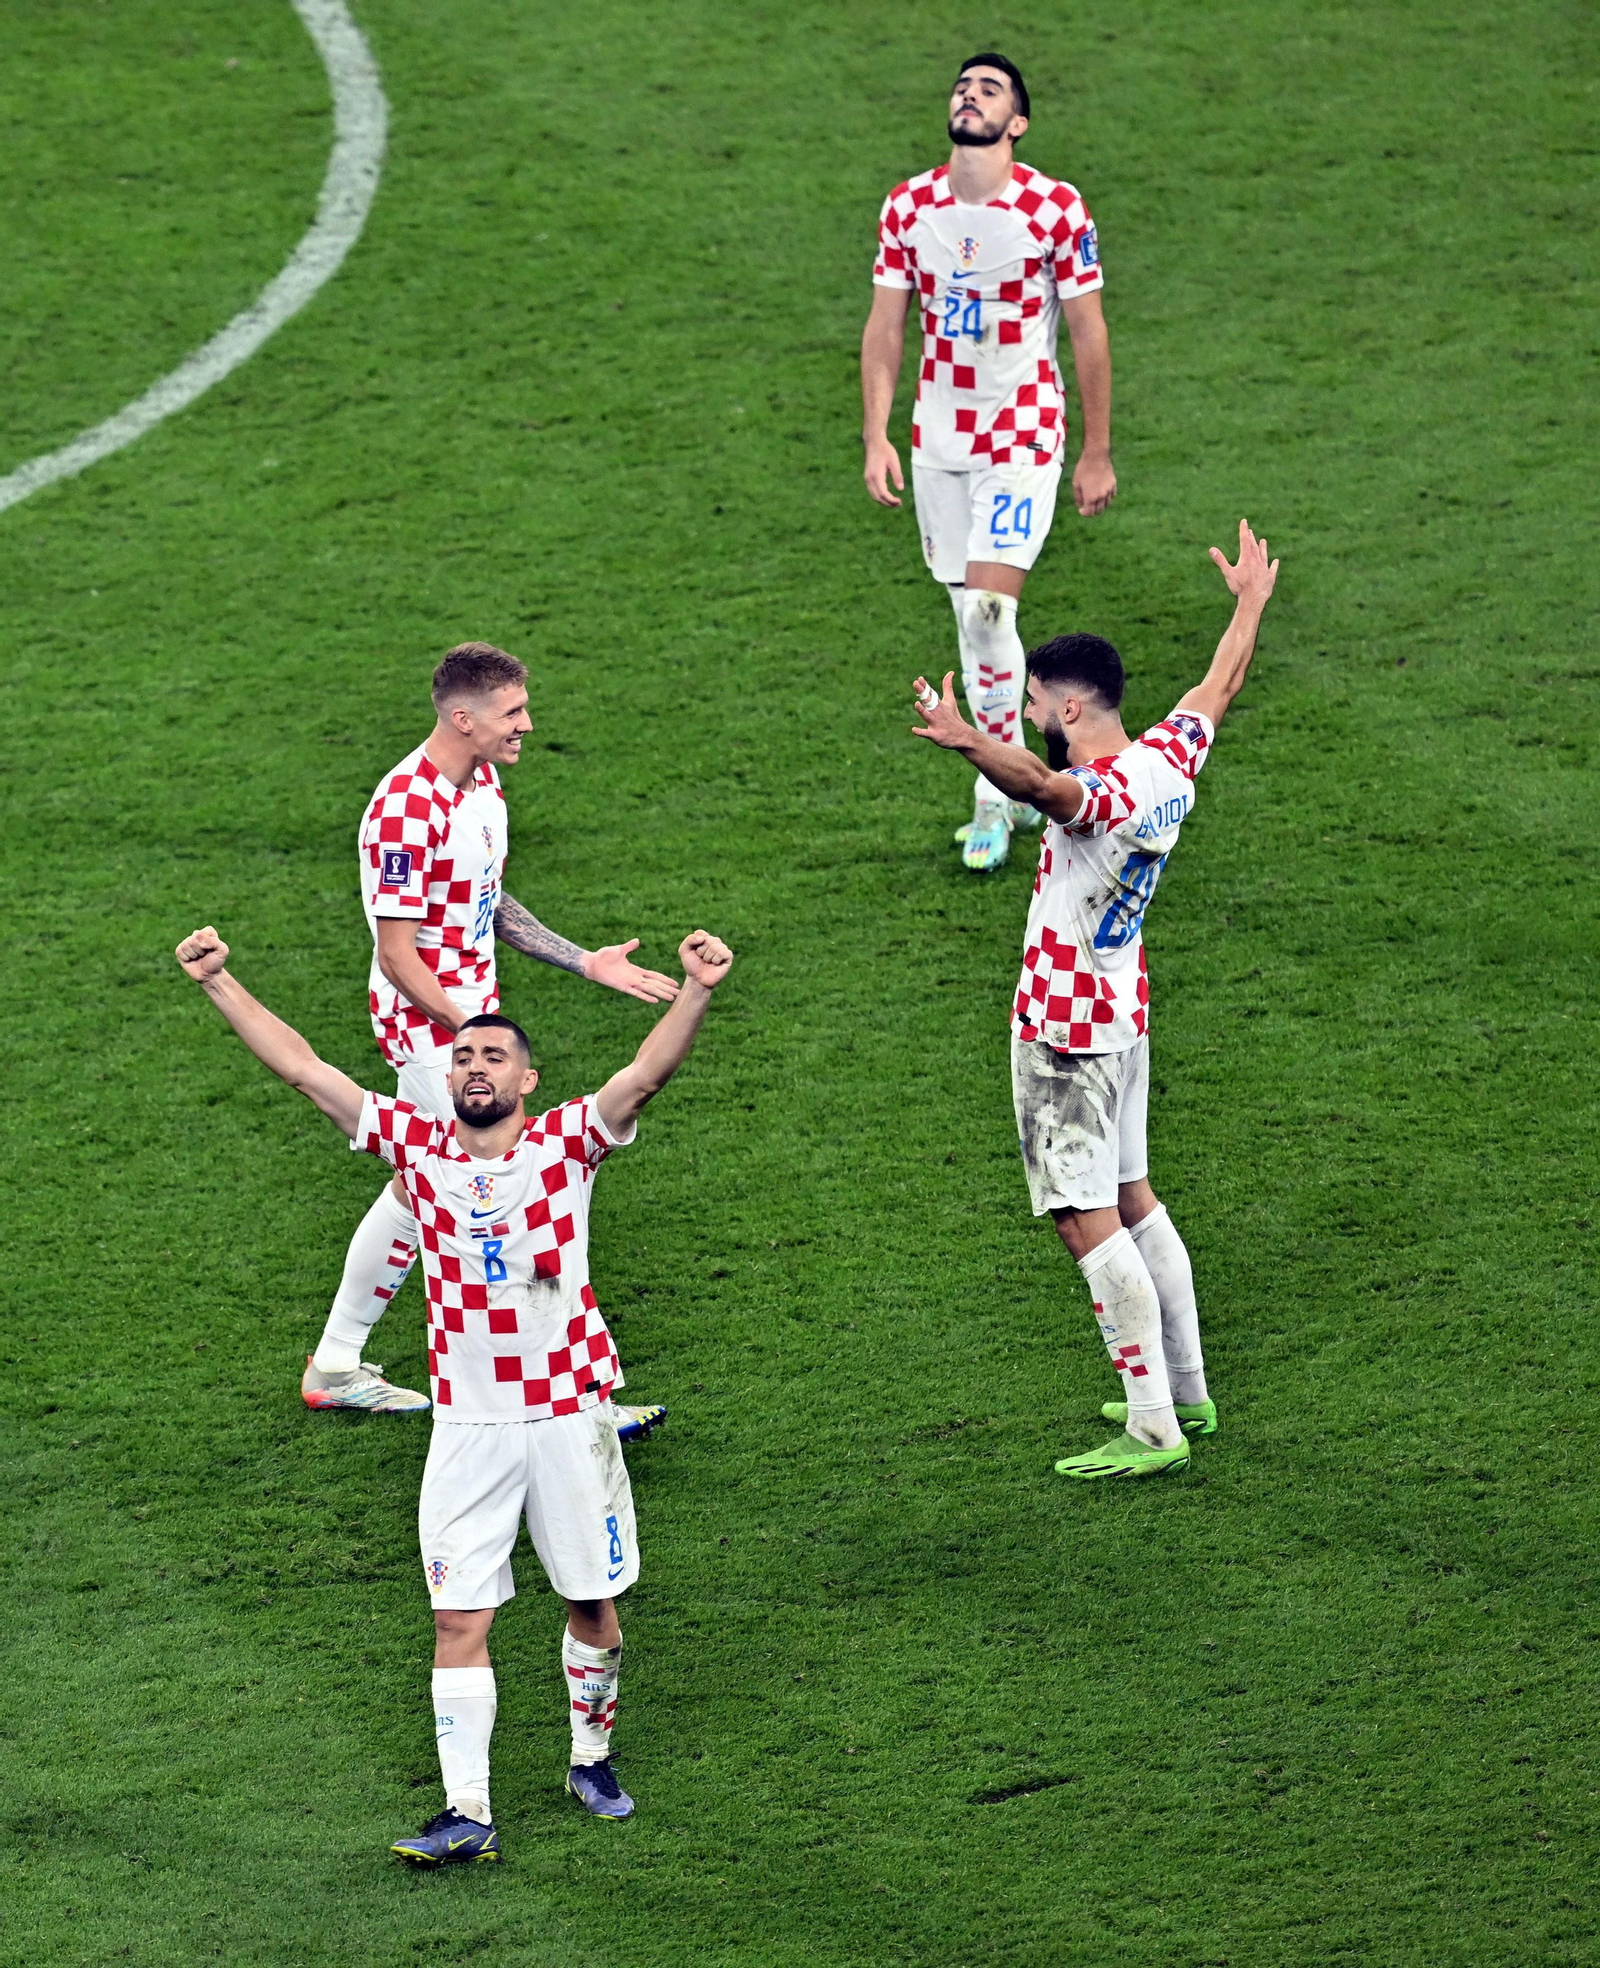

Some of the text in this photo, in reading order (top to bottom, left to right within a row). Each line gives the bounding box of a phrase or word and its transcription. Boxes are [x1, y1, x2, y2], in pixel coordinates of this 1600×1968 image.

[943, 296, 983, 342] 24
[990, 494, 1032, 540] 24
[482, 1240, 508, 1283] 8
[605, 1514, 624, 1565] 8
